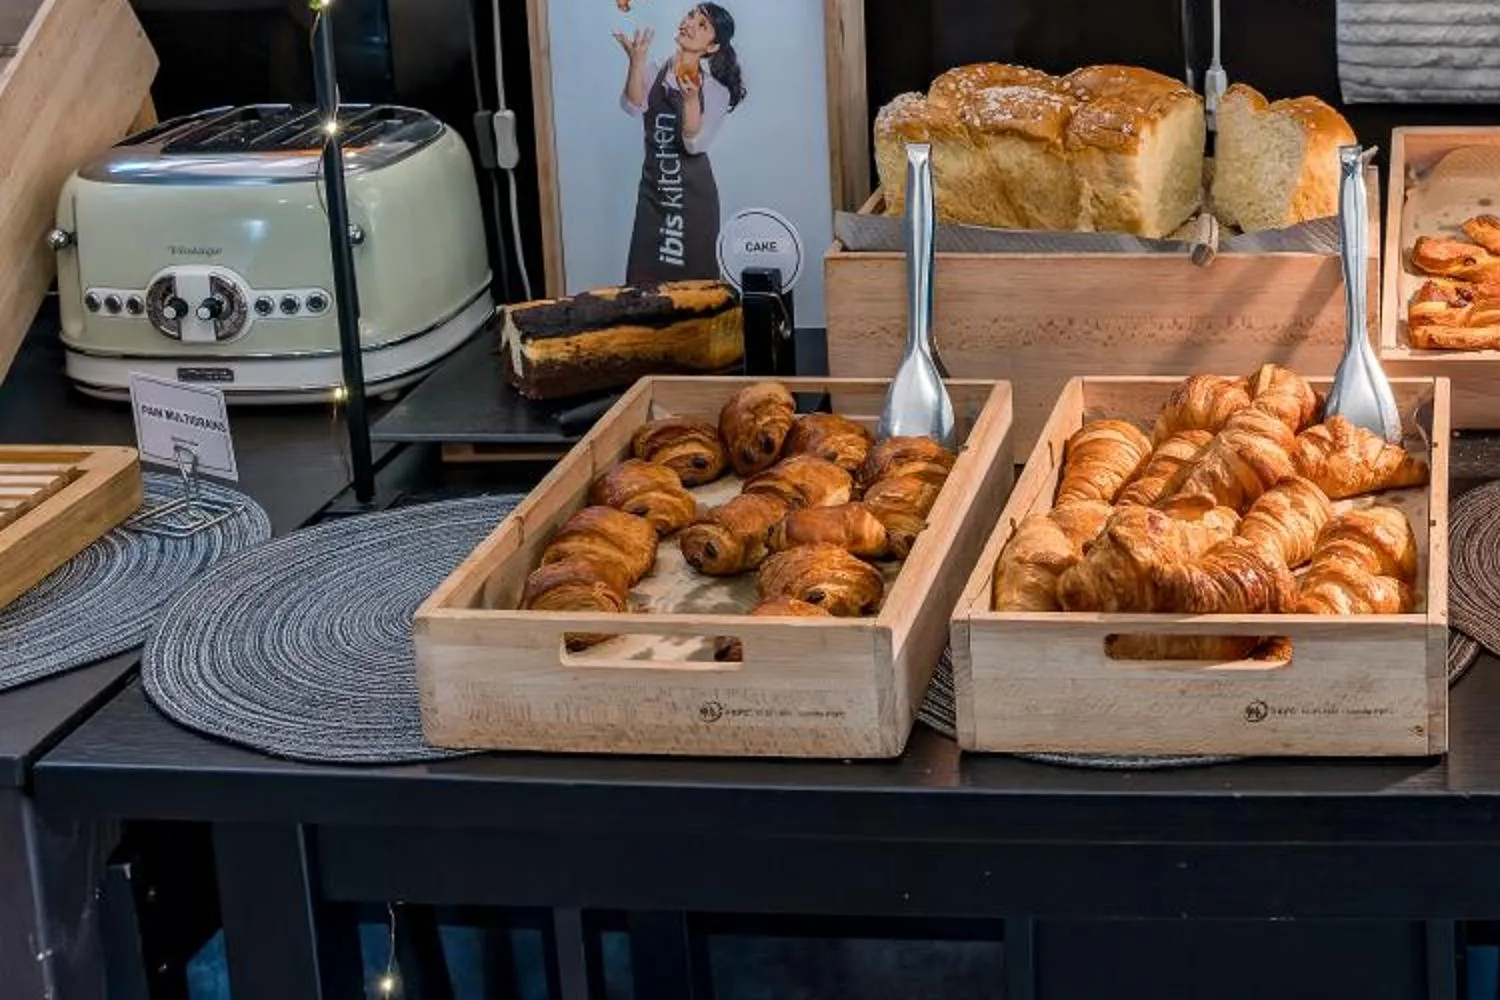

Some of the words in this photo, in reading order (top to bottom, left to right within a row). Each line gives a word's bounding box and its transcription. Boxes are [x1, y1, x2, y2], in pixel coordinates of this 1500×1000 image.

[654, 113, 684, 208] kitchen
[659, 213, 686, 267] ibis
[745, 241, 777, 253] CAKE
